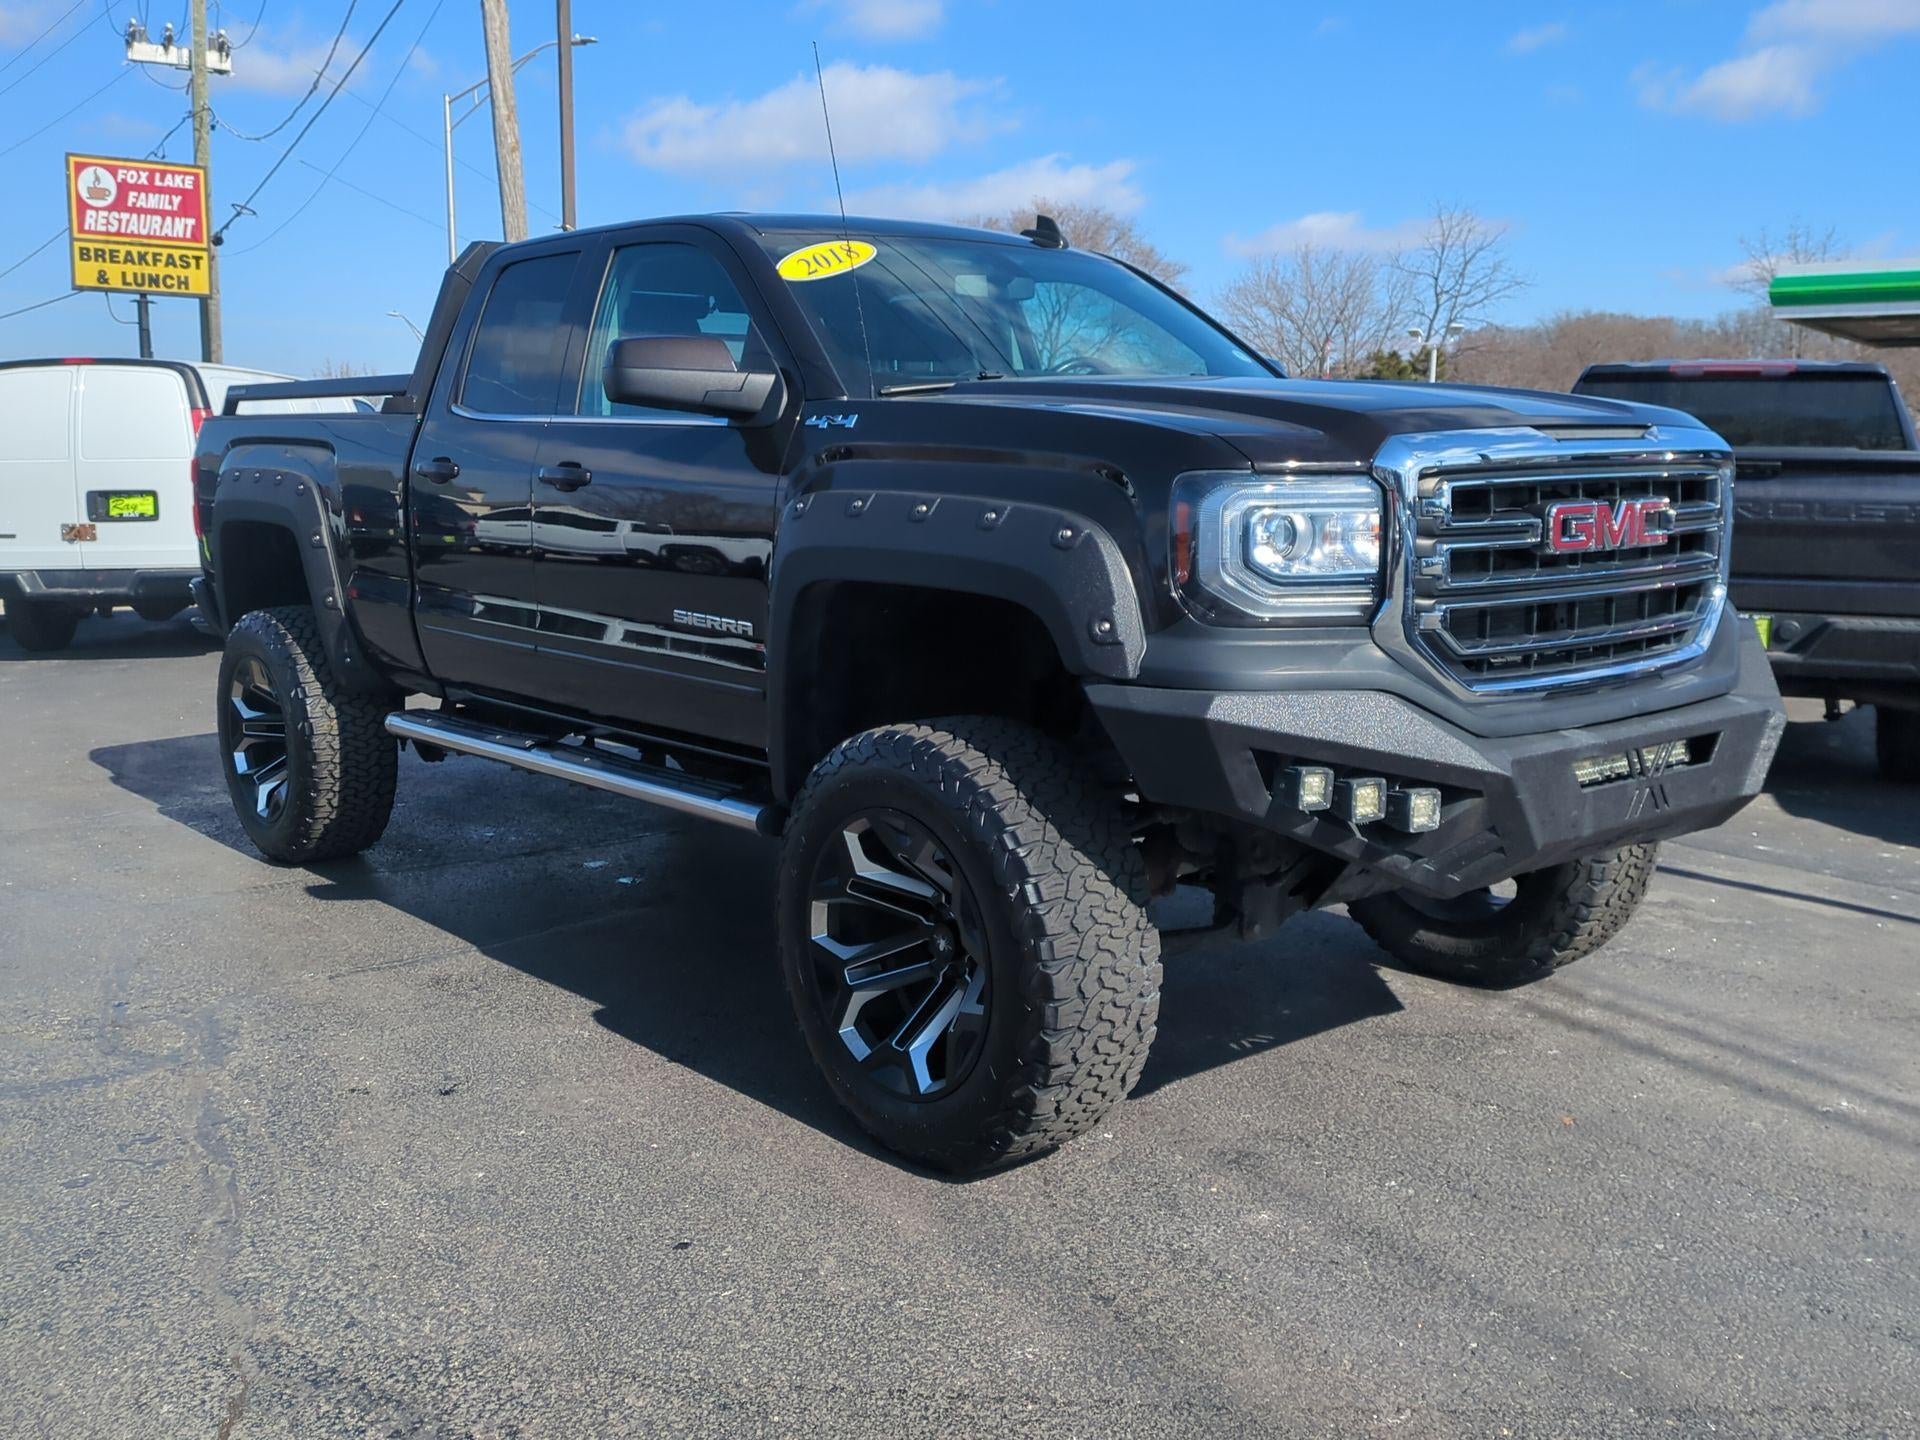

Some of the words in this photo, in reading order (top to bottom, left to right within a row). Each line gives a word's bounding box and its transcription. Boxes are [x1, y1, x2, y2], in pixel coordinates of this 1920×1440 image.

[117, 169, 149, 185] FOX
[154, 172, 194, 189] LAKE
[127, 191, 182, 211] FAMILY
[84, 209, 196, 238] RESTAURANT
[79, 247, 203, 270] BREAKFAST
[797, 243, 860, 275] 2018
[97, 270, 110, 284] &
[121, 271, 189, 290] LUNCH
[1546, 496, 1675, 553] GMC
[673, 609, 754, 636] SIERRA
